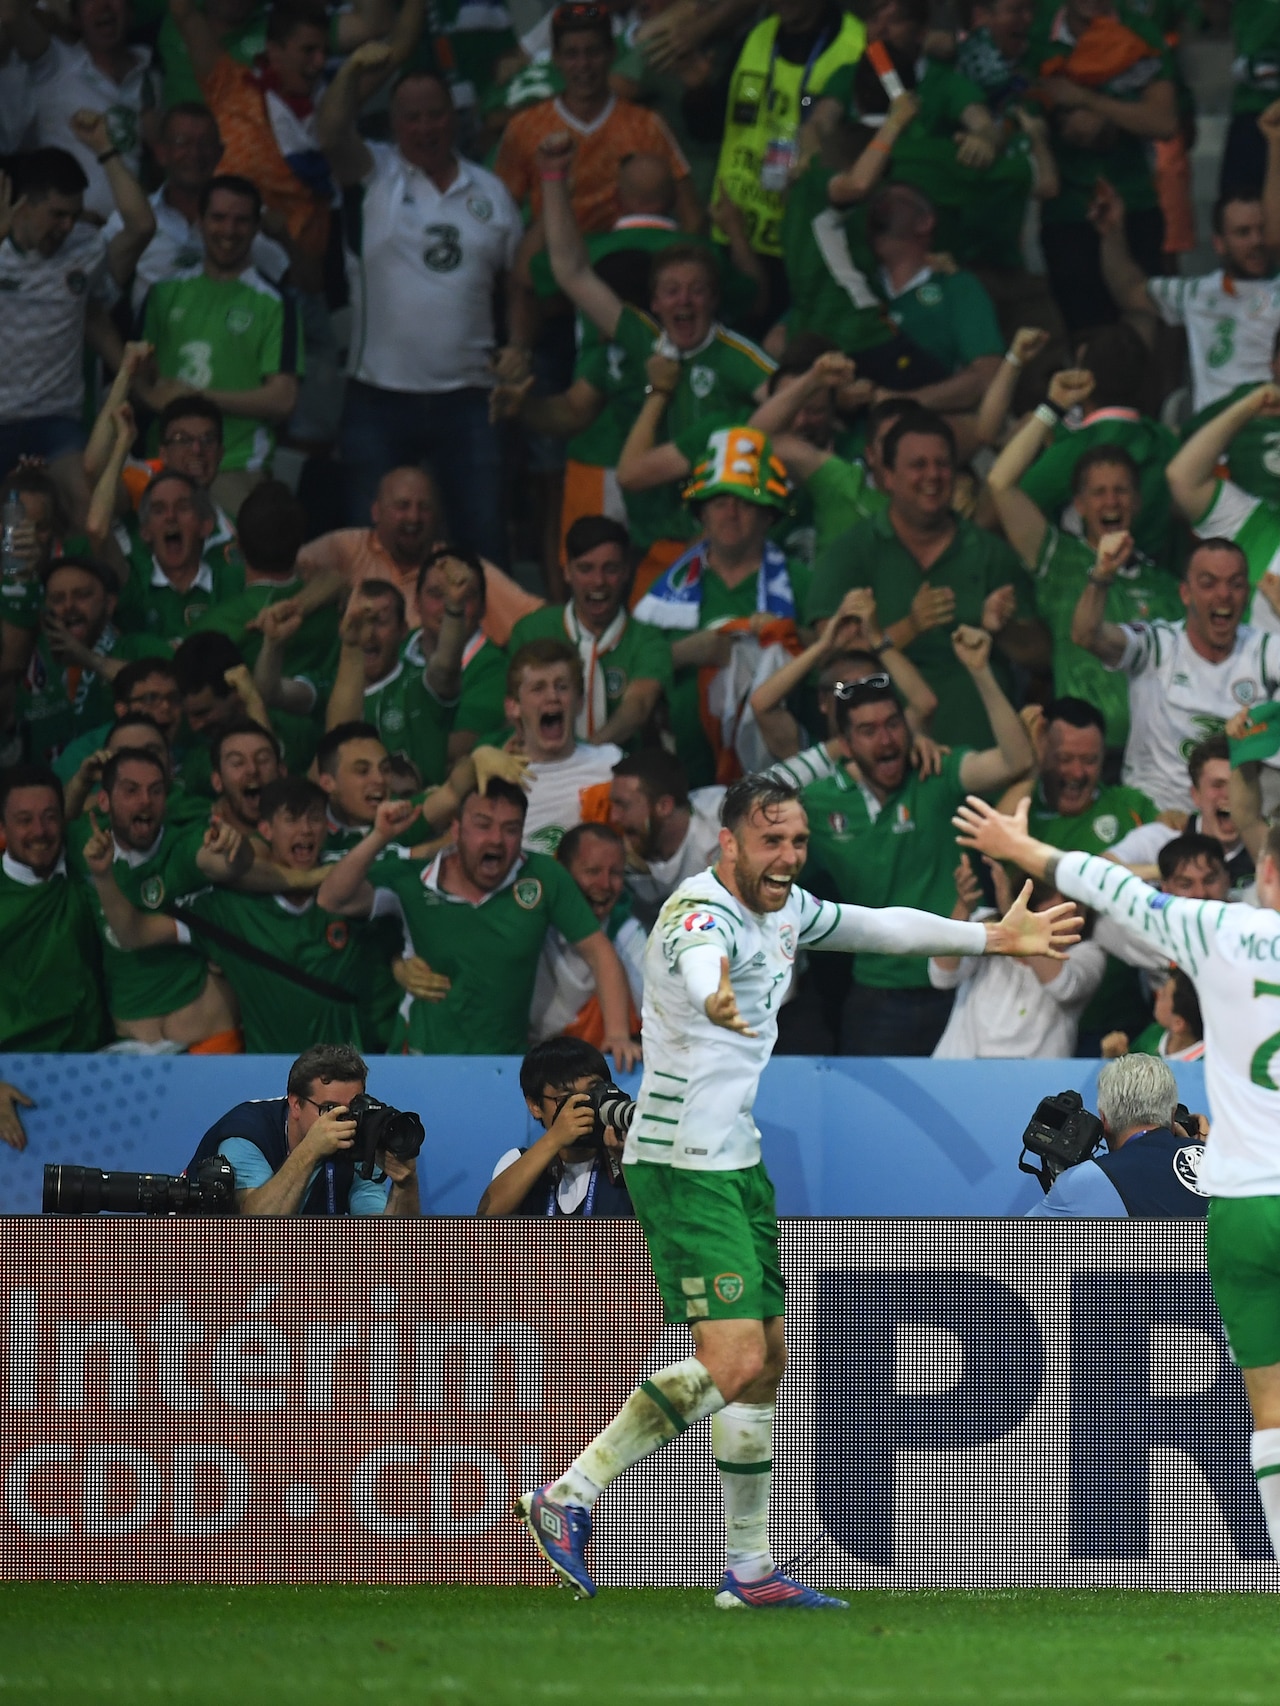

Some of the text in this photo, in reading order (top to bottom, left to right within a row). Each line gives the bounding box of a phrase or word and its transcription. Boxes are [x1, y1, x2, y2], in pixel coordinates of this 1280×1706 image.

[423, 224, 462, 273] 3
[9, 1283, 542, 1412] Intérim
[8, 1443, 249, 1538] CDD
